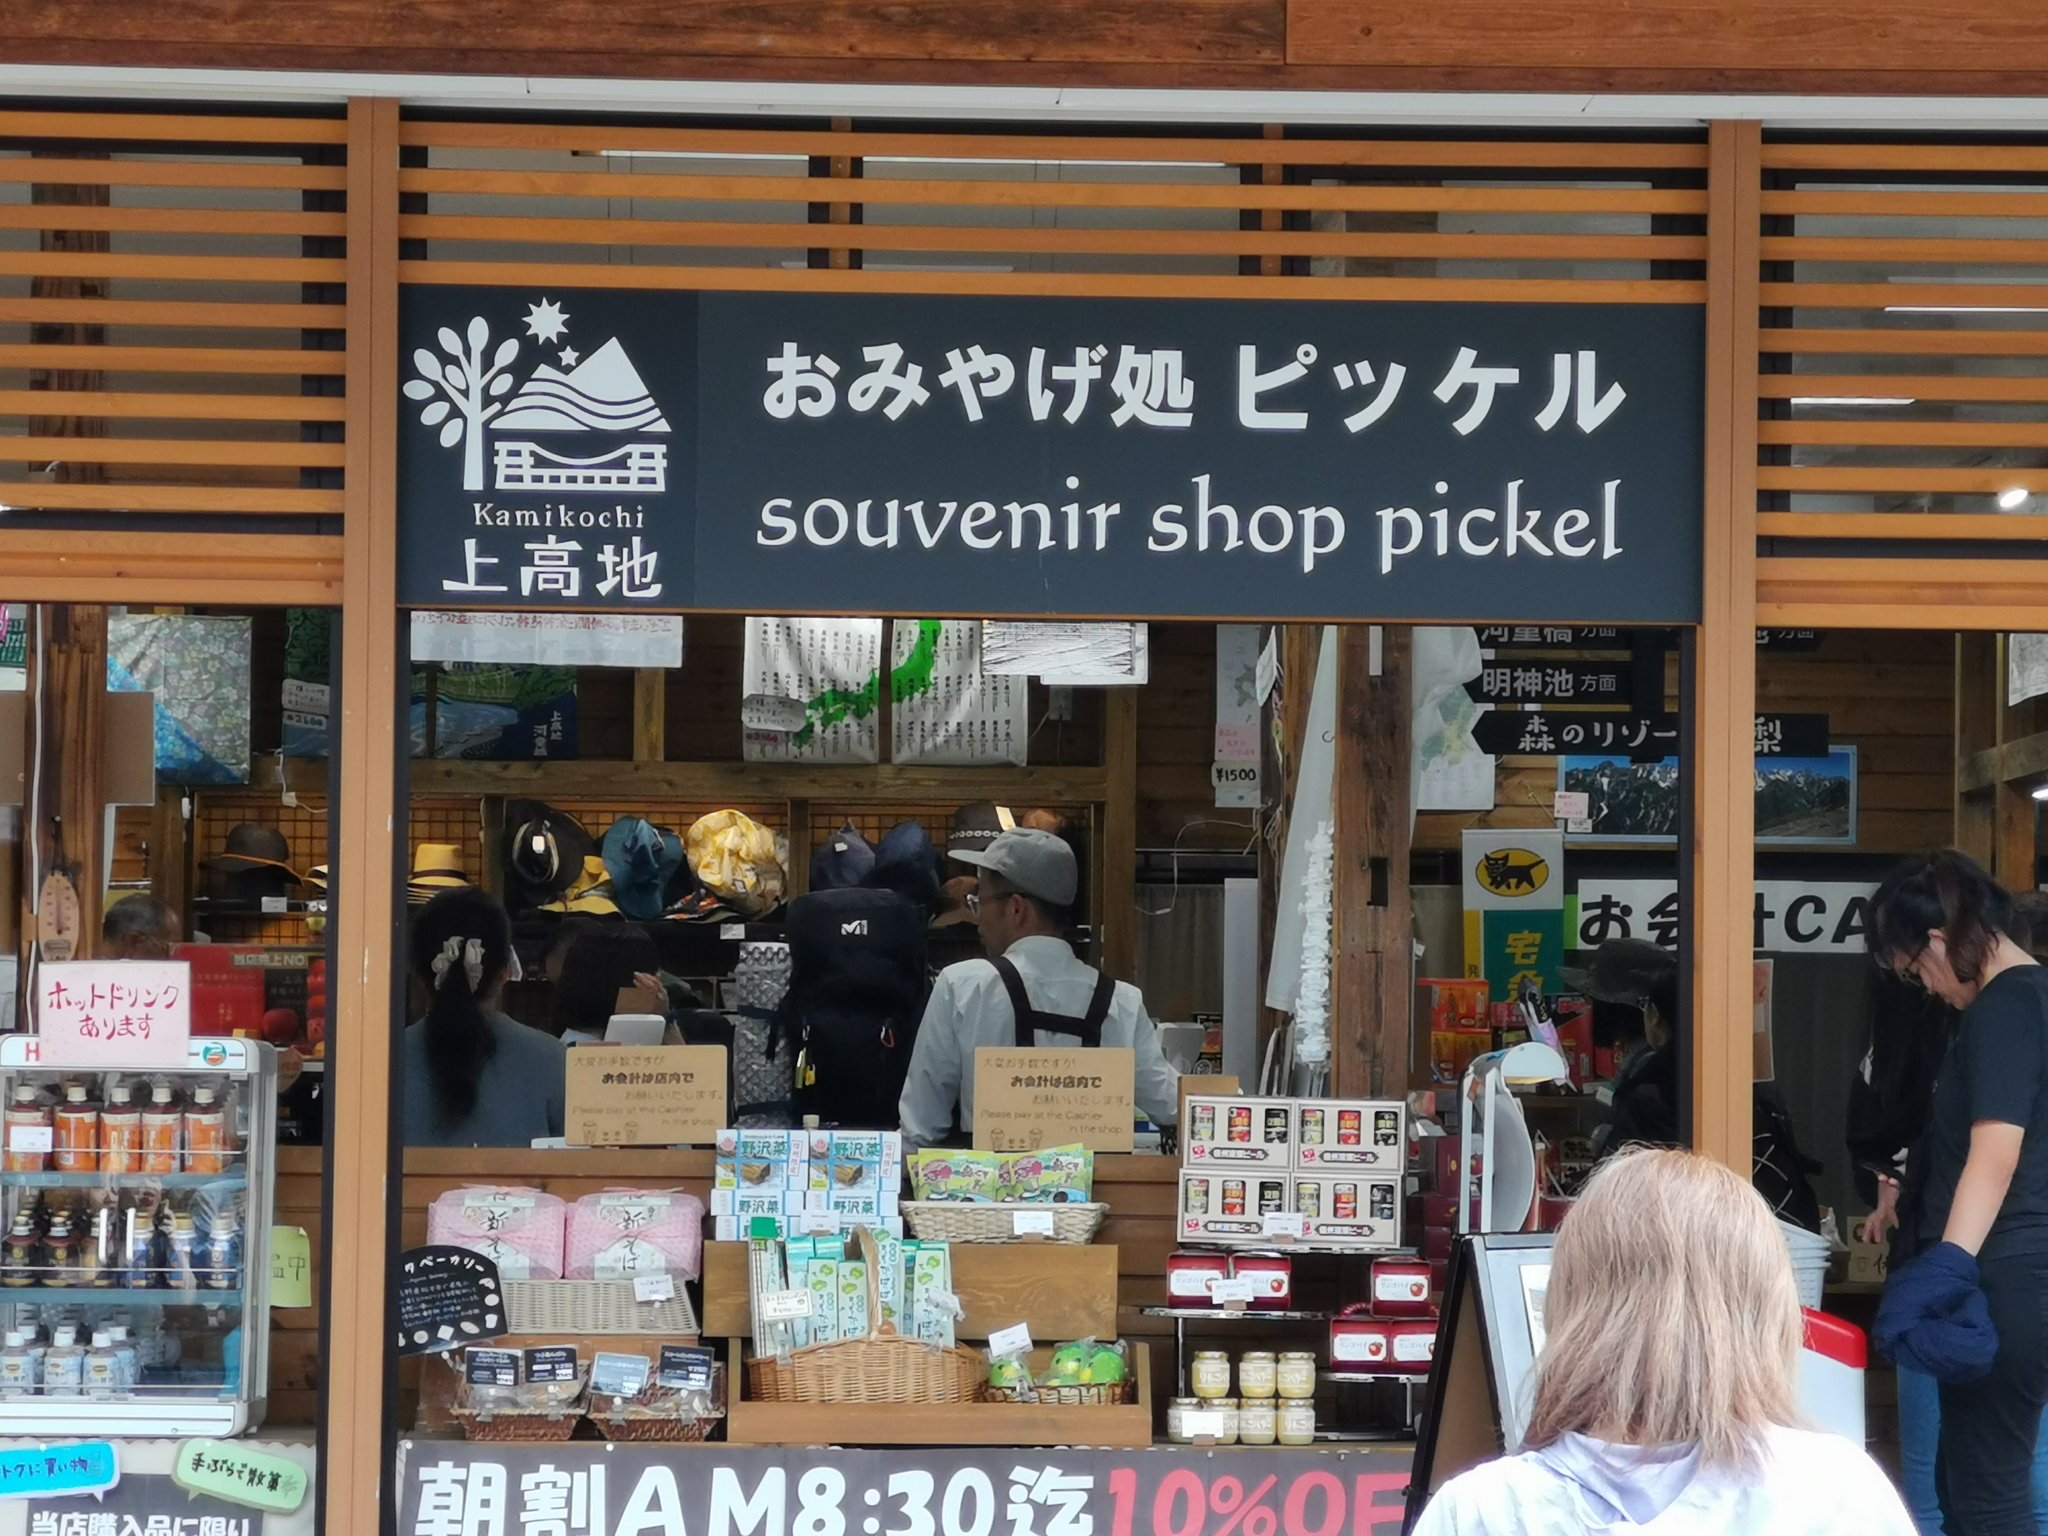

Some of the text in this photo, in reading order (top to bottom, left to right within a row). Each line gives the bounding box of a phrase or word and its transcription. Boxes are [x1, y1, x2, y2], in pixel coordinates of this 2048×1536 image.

[763, 341, 1627, 435] おみやげ処 ピッケル
[473, 503, 645, 529] Kamikochi
[757, 473, 1624, 575] souvenir shop pickel
[442, 535, 663, 598] 上高地
[1482, 667, 1617, 697] 明神池 方面
[1216, 768, 1257, 782] ¥1500
[48, 981, 180, 1010] ホットドリンク
[79, 1013, 154, 1041] あります
[602, 1072, 694, 1085] お会計は店内で
[1011, 1075, 1103, 1089] お会計は店内で
[741, 1140, 788, 1157] 野沢菜
[834, 1141, 880, 1158] 野沢菜
[738, 1200, 779, 1215] 野沢菜
[833, 1200, 875, 1215] 野沢菜
